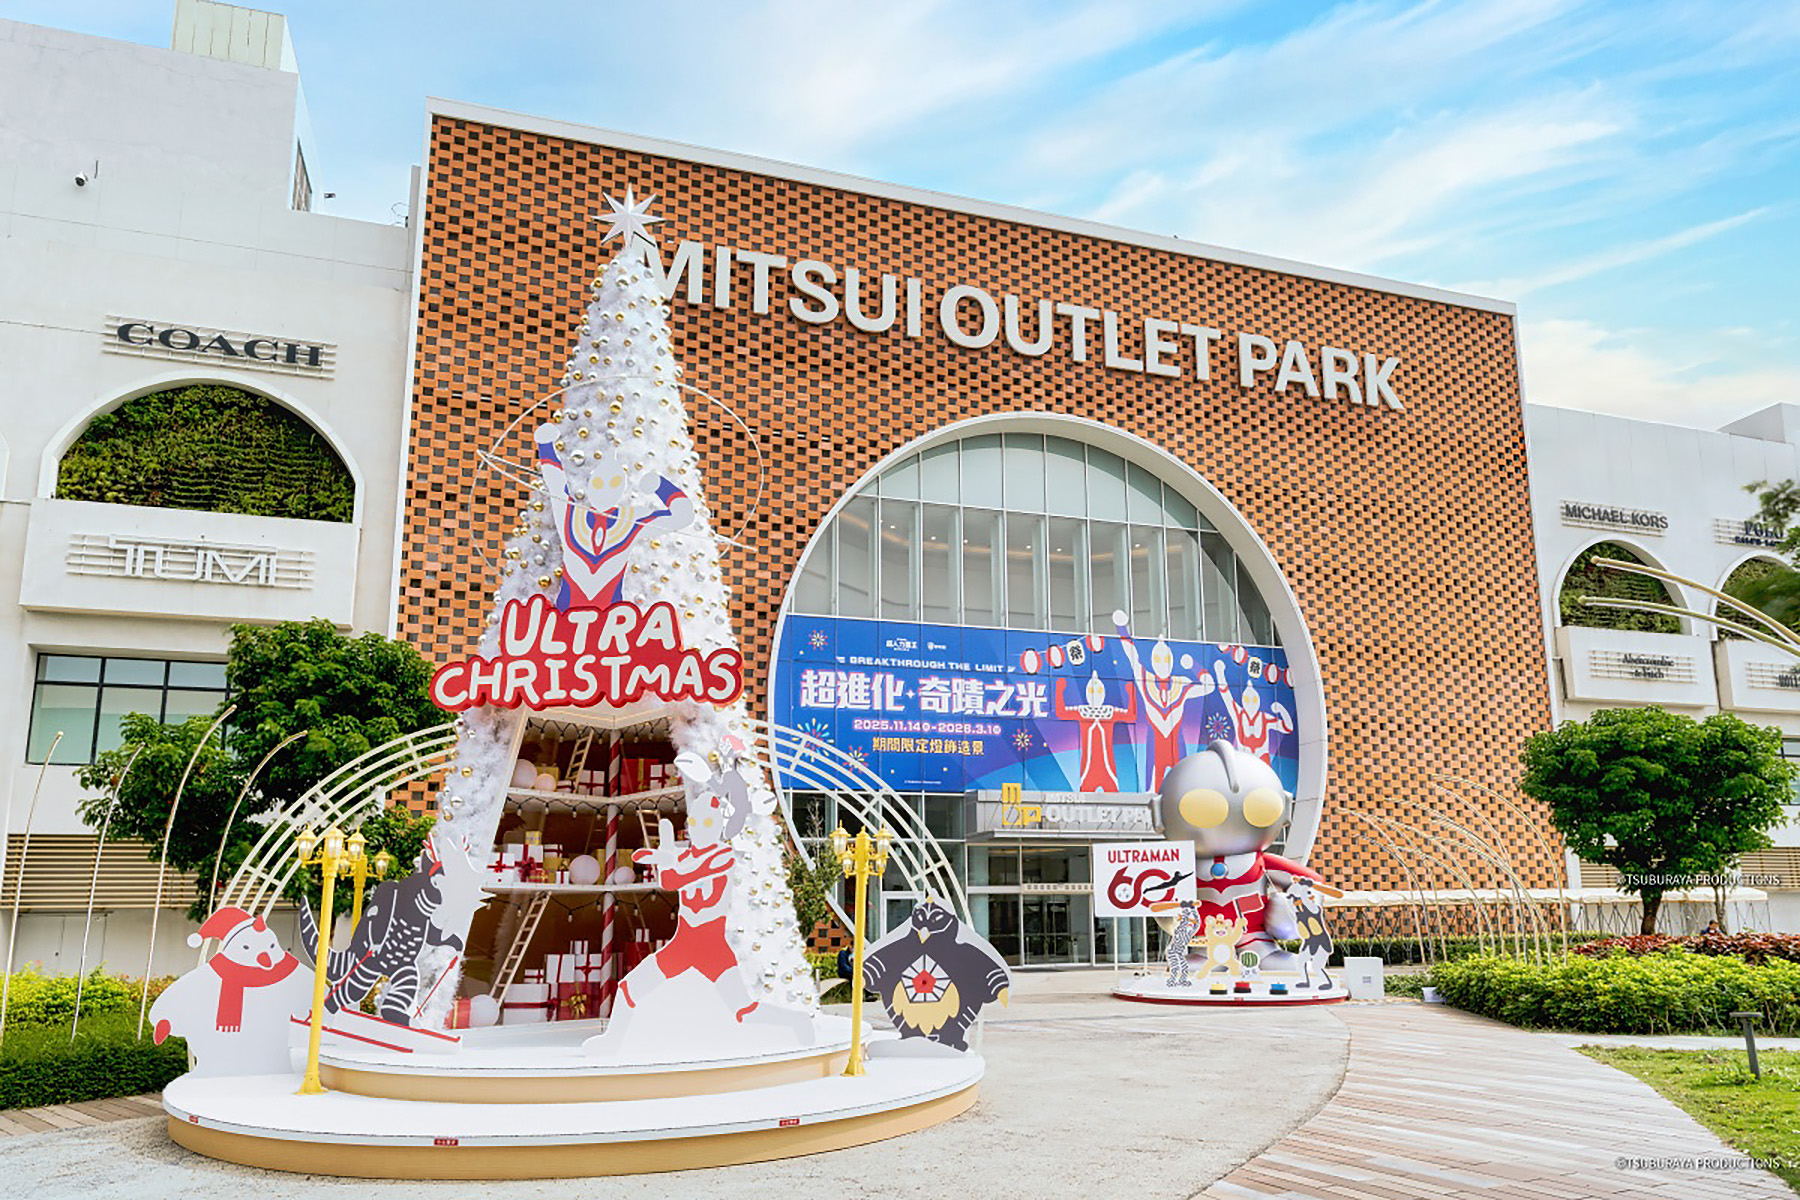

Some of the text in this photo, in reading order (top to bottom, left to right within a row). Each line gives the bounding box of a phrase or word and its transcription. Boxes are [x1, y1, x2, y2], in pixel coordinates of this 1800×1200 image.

[631, 231, 1405, 411] MITSUI OUTLET PARK
[117, 322, 324, 367] COACH
[1564, 503, 1669, 529] MICHAEL KORS
[109, 534, 277, 586] TUMI
[504, 597, 676, 657] ULTRA
[434, 653, 737, 706] CHRISTMAS
[850, 656, 1003, 673] BREAKTHROUGH THE LIMIT
[1045, 805, 1122, 822] OUTLET
[1107, 848, 1180, 864] ULTRAMAN
[1107, 865, 1175, 910] 60
